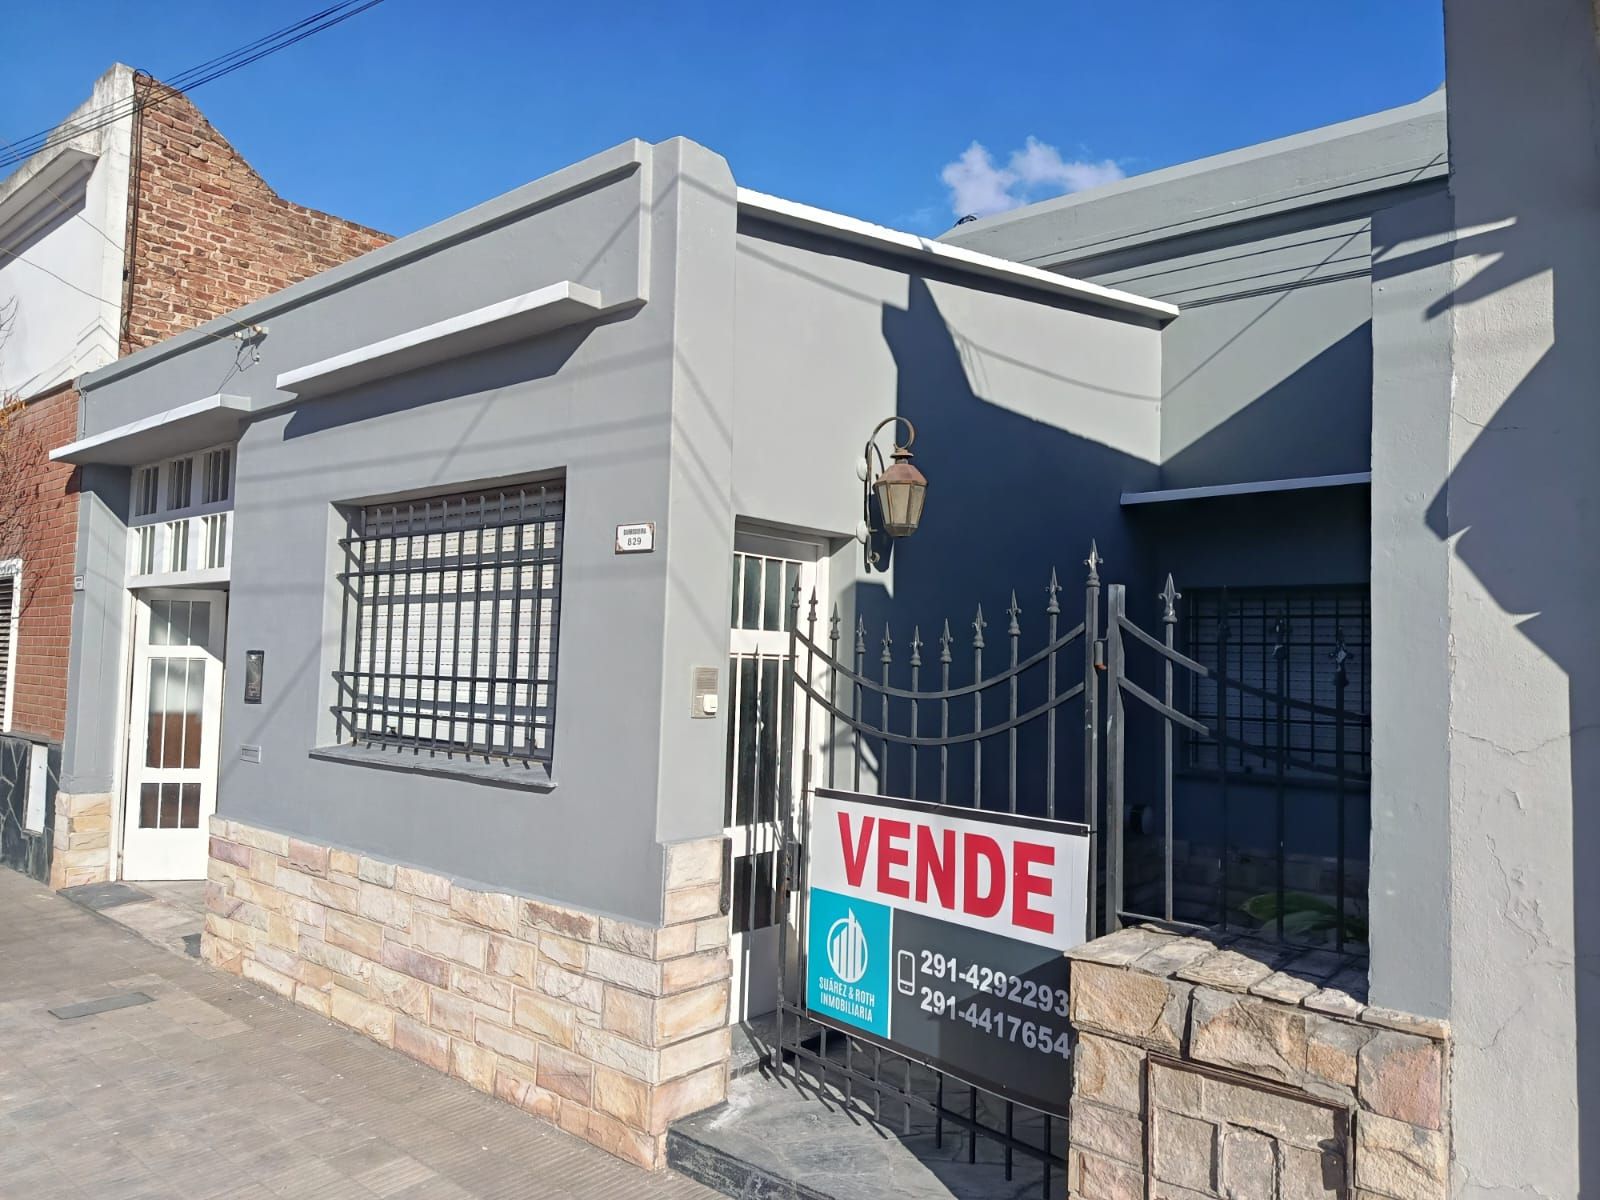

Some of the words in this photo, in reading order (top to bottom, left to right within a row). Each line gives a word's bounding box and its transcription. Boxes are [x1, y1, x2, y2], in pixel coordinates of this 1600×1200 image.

[837, 811, 1055, 934] VENDE
[819, 977, 848, 997] SUÁREZ
[848, 986, 854, 1000] &
[855, 988, 875, 1008] ROTH
[820, 993, 873, 1023] INMOBILIARIA
[920, 950, 1069, 1018] 291-4292293
[920, 986, 1071, 1060] 291-4417654
